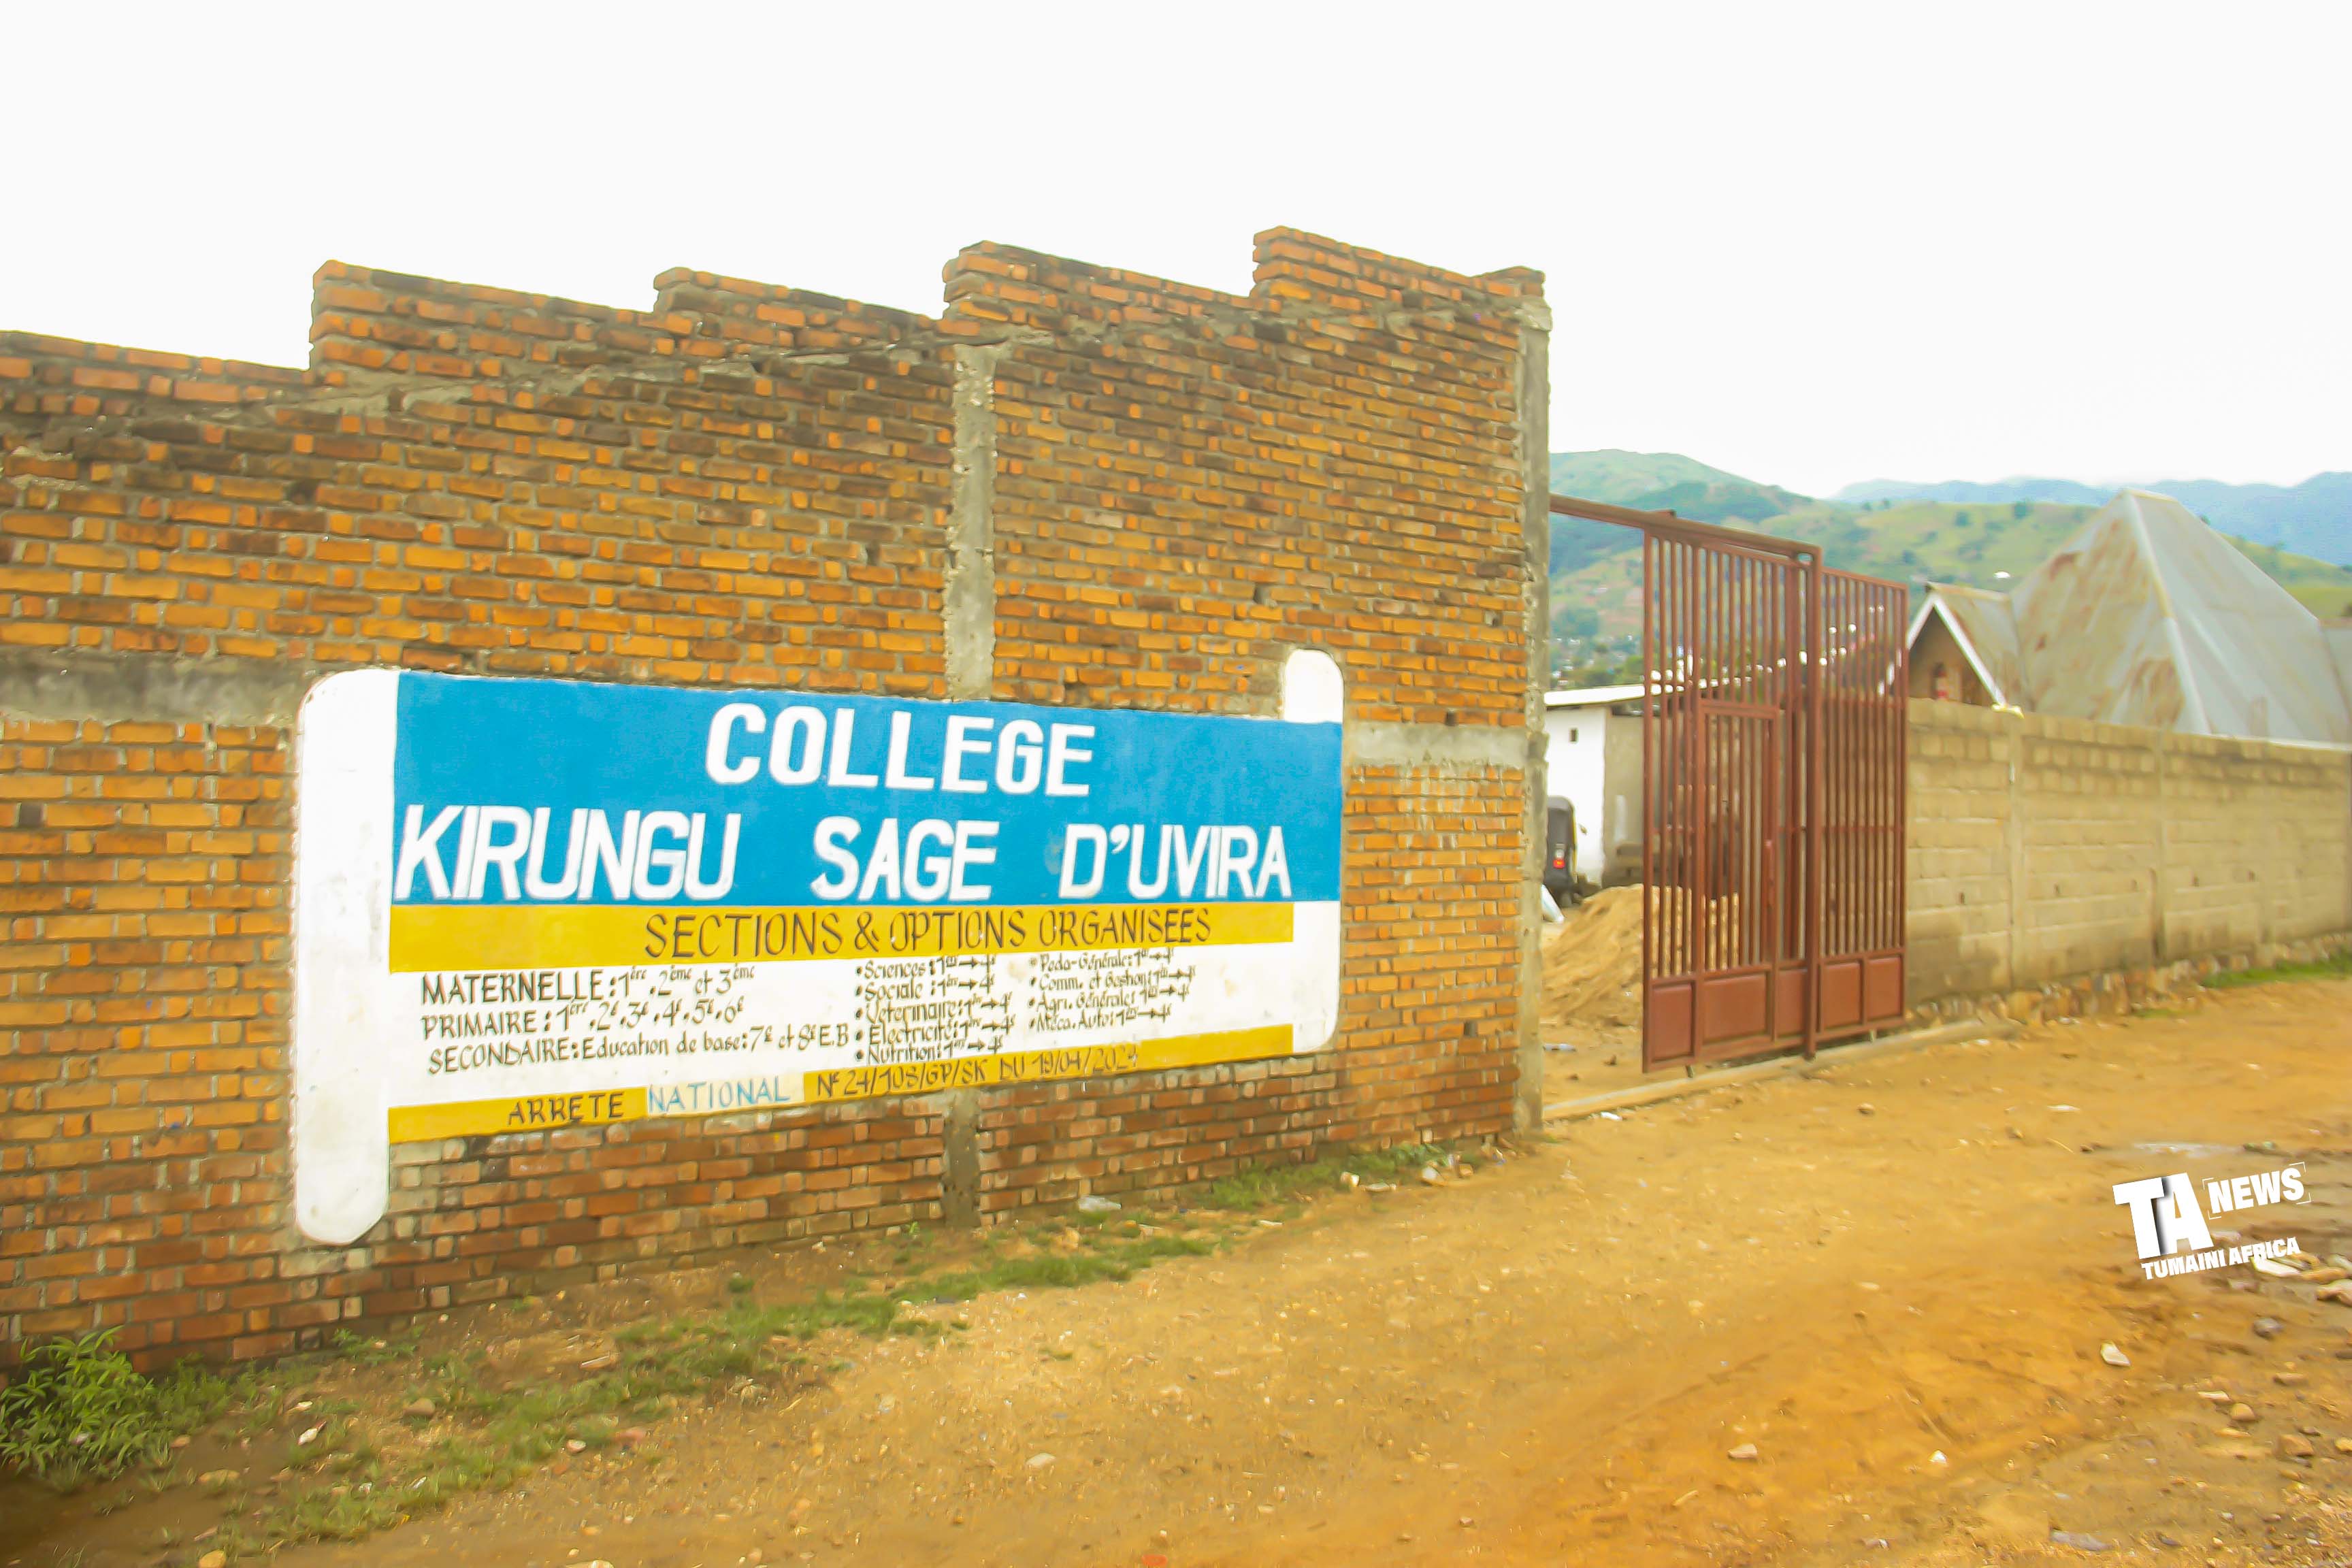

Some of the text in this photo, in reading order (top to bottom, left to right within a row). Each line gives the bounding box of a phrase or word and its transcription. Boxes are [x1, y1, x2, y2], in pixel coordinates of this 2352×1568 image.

[706, 702, 1095, 798] COLLEGE
[395, 804, 1291, 902] KIRUNGU SAGE D'UVIRA
[645, 908, 1211, 958] SECTIONS & OPTIONS ORGANISEES
[696, 970, 713, 994] et
[583, 1032, 669, 1058] Education
[677, 1030, 697, 1052] de
[508, 1092, 625, 1126] ARRETE
[649, 1075, 790, 1113] NATIONAL
